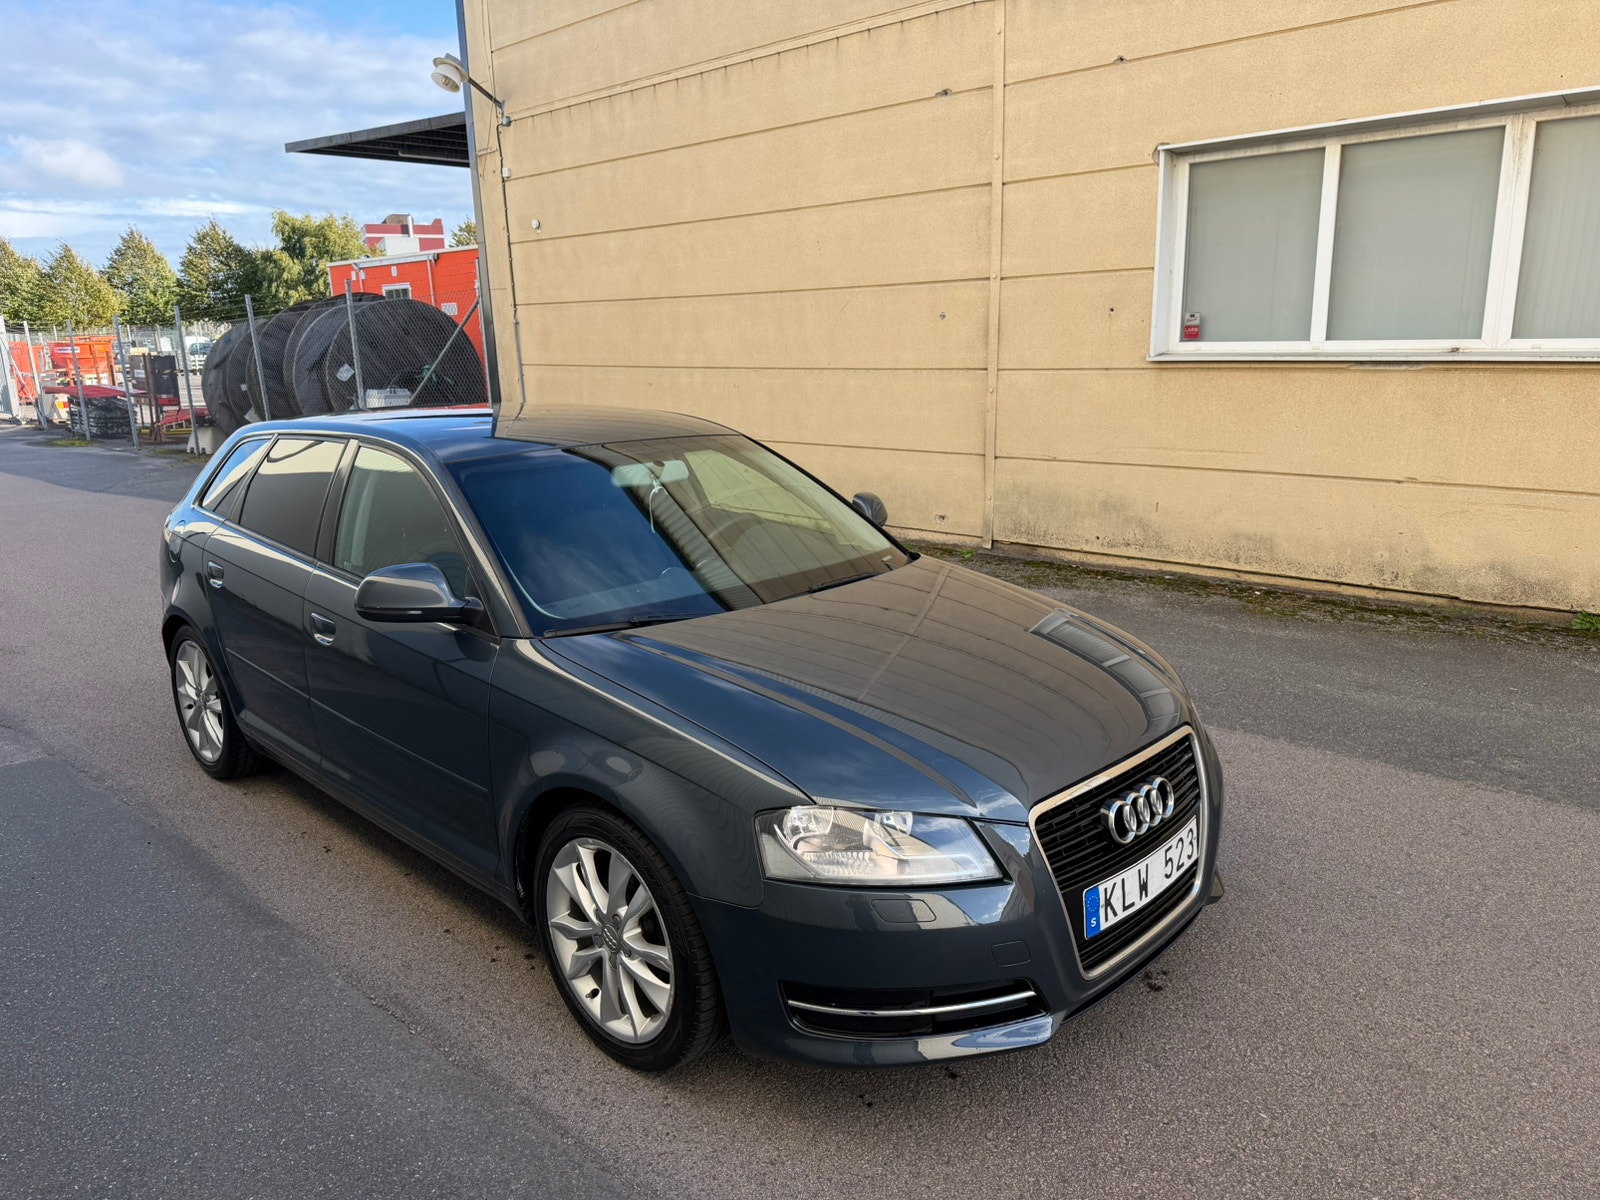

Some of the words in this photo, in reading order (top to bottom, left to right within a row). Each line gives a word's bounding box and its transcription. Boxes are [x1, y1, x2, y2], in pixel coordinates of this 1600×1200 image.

[1104, 863, 1149, 922] KLW
[1164, 827, 1194, 879] 523
[1091, 917, 1097, 927] S
